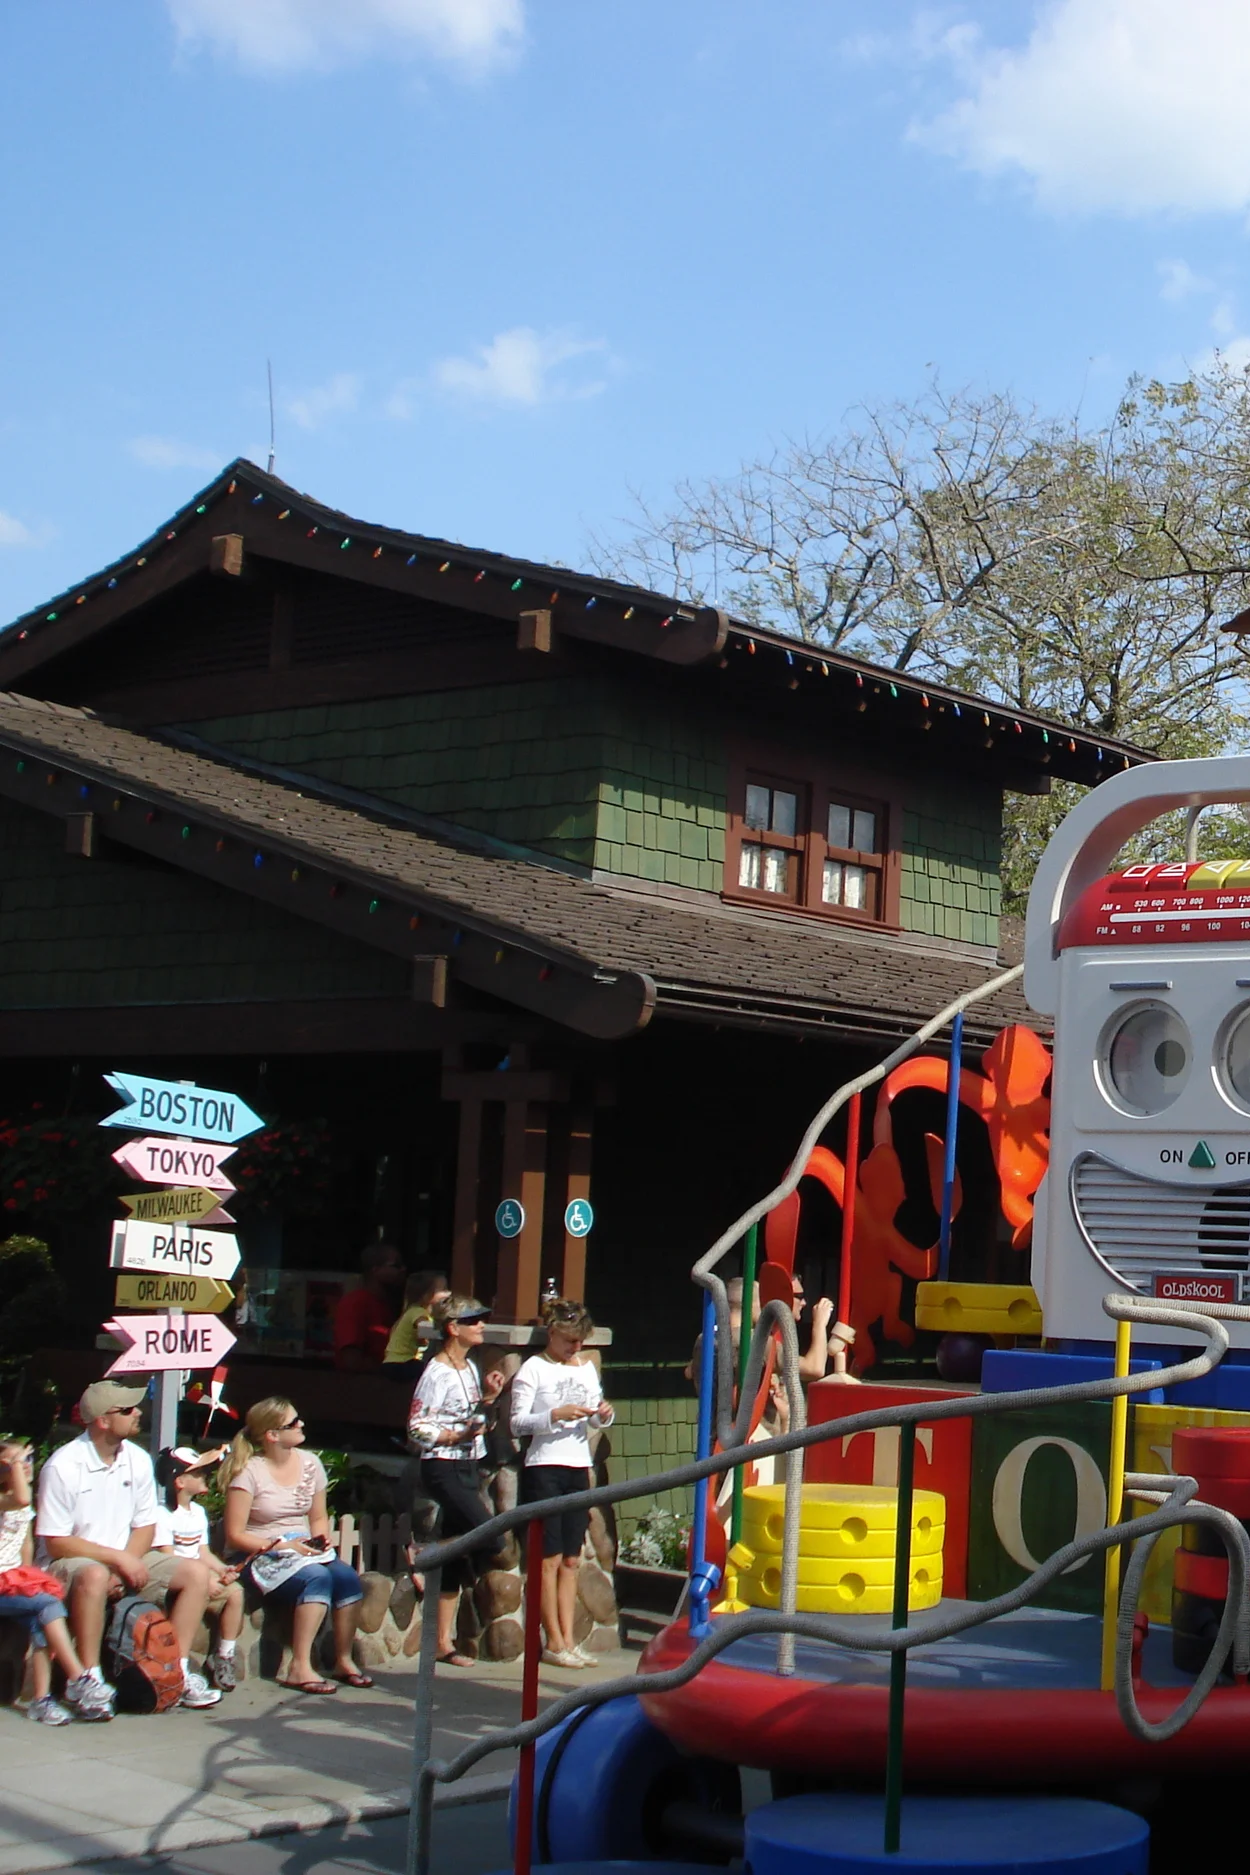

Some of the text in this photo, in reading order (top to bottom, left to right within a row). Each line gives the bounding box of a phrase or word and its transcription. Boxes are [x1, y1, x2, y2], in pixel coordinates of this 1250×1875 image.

[1100, 903, 1113, 911] AM
[1134, 900, 1149, 908] 530
[1172, 898, 1187, 906] 700
[1216, 896, 1235, 904] 1000
[1096, 927, 1109, 935] FM
[1155, 924, 1165, 933] 92
[1207, 922, 1221, 931] 100
[139, 1087, 235, 1133] BOSTON
[146, 1146, 215, 1178] TOKYO
[1159, 1149, 1184, 1164] ON
[136, 1191, 204, 1220] MILWAUKEE
[152, 1235, 213, 1266] PARIS
[137, 1279, 197, 1302] ORLANDO
[1162, 1281, 1226, 1299] OLDSKOOL
[145, 1328, 213, 1355] ROME
